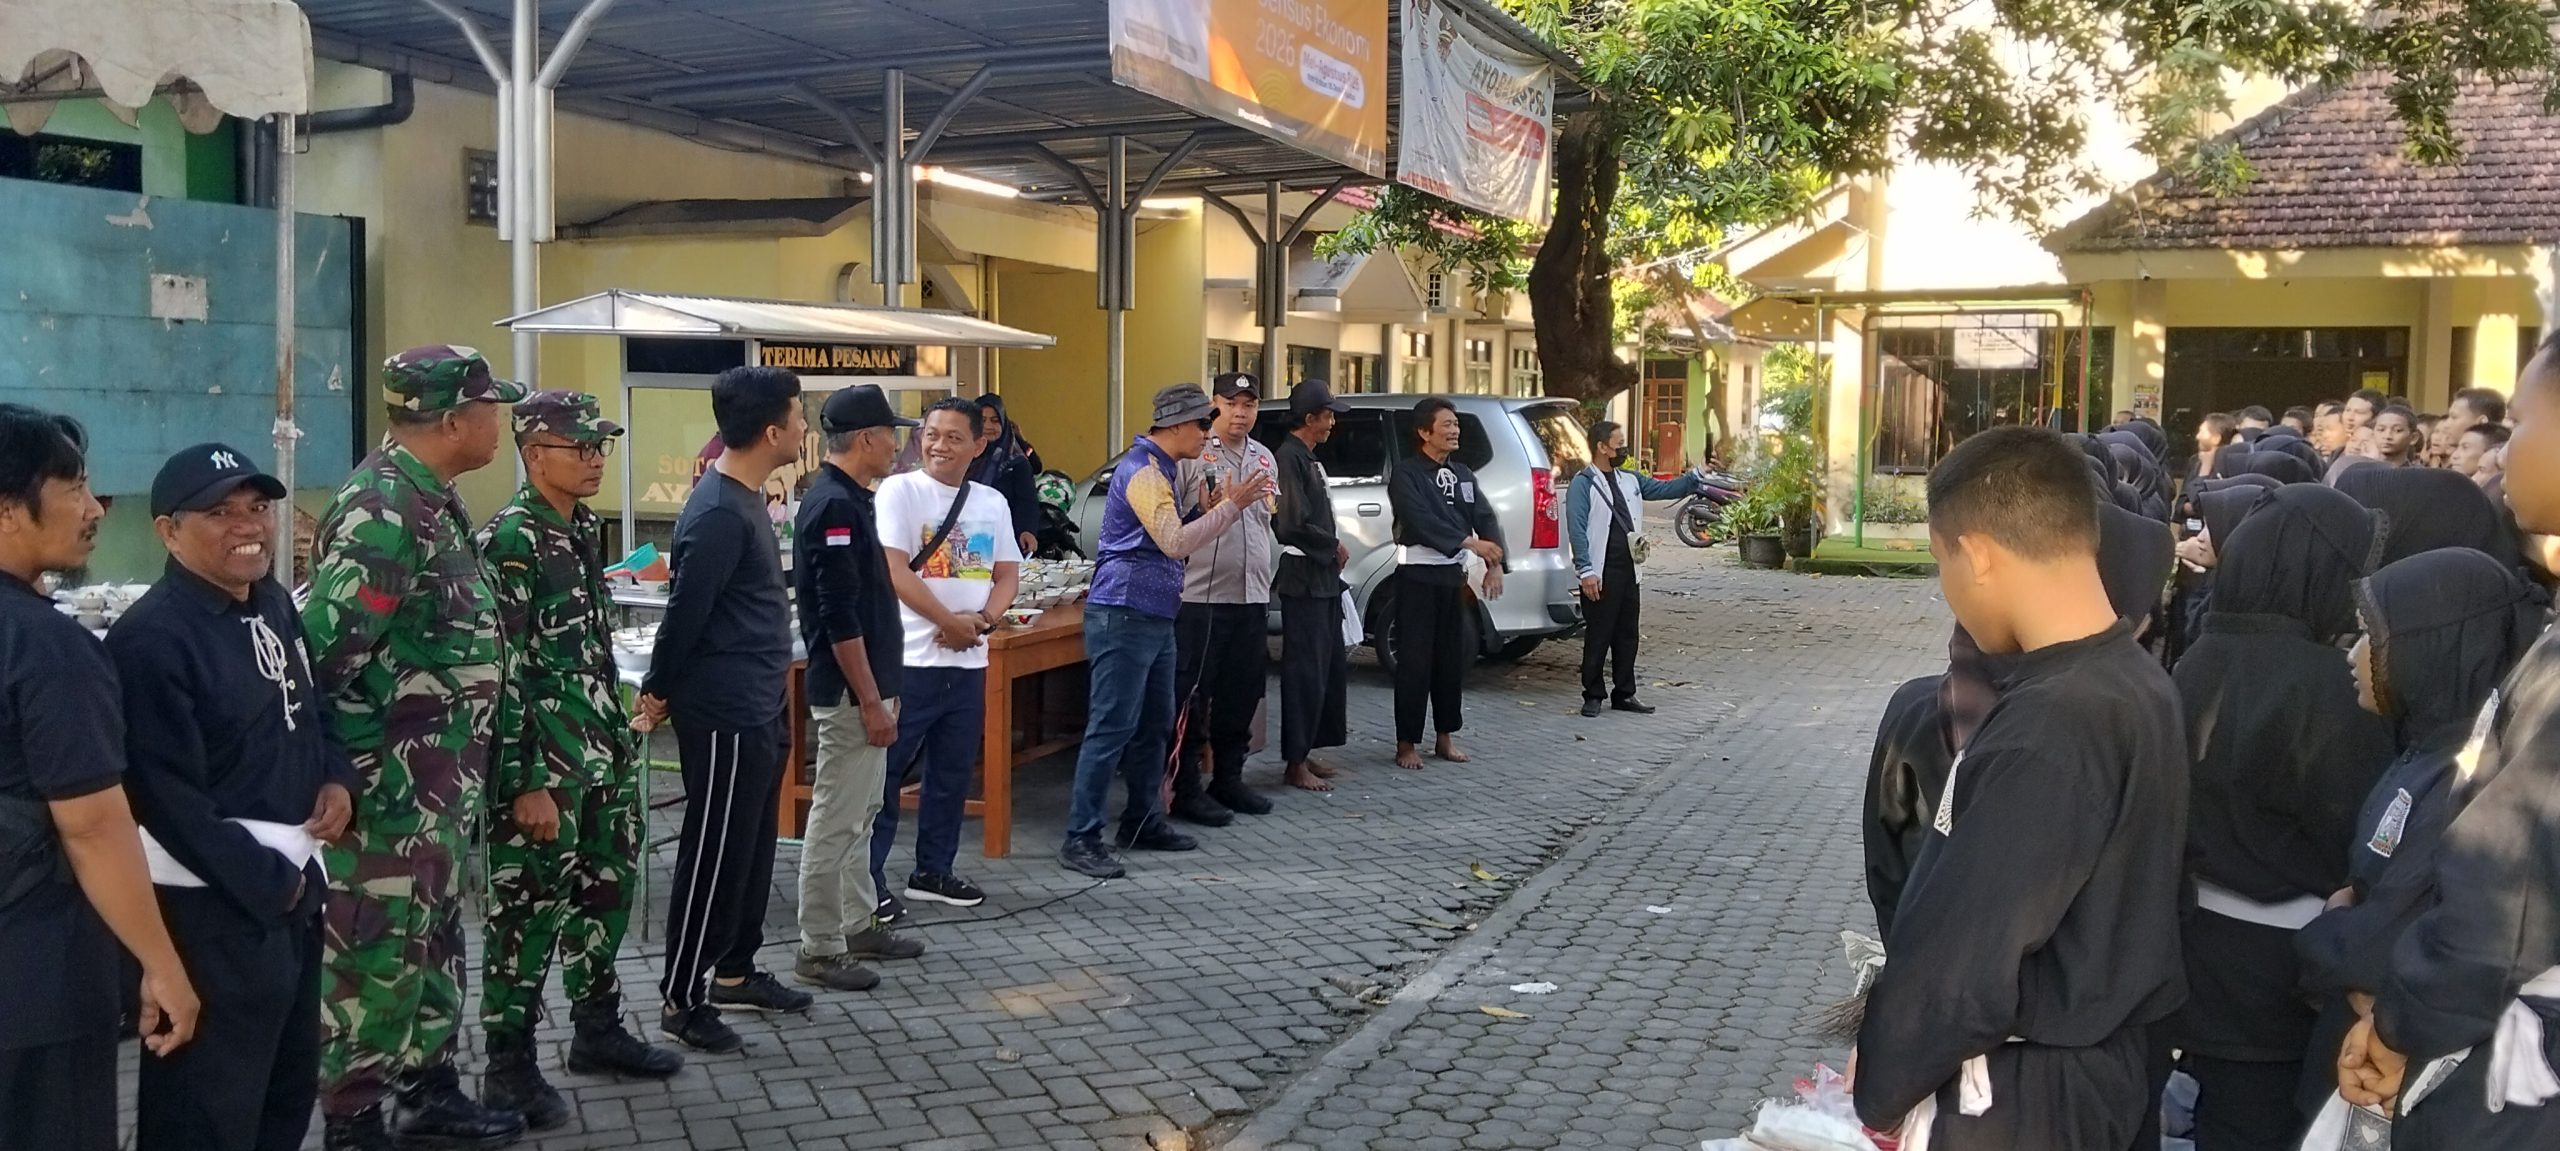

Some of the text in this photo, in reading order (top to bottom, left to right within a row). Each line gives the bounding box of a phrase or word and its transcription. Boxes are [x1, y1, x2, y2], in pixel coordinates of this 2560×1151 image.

[1259, 0, 1313, 32] ensus
[1256, 17, 1296, 68] 2026
[762, 346, 901, 369] TERIMA PESANAN
[640, 482, 692, 503] AY
